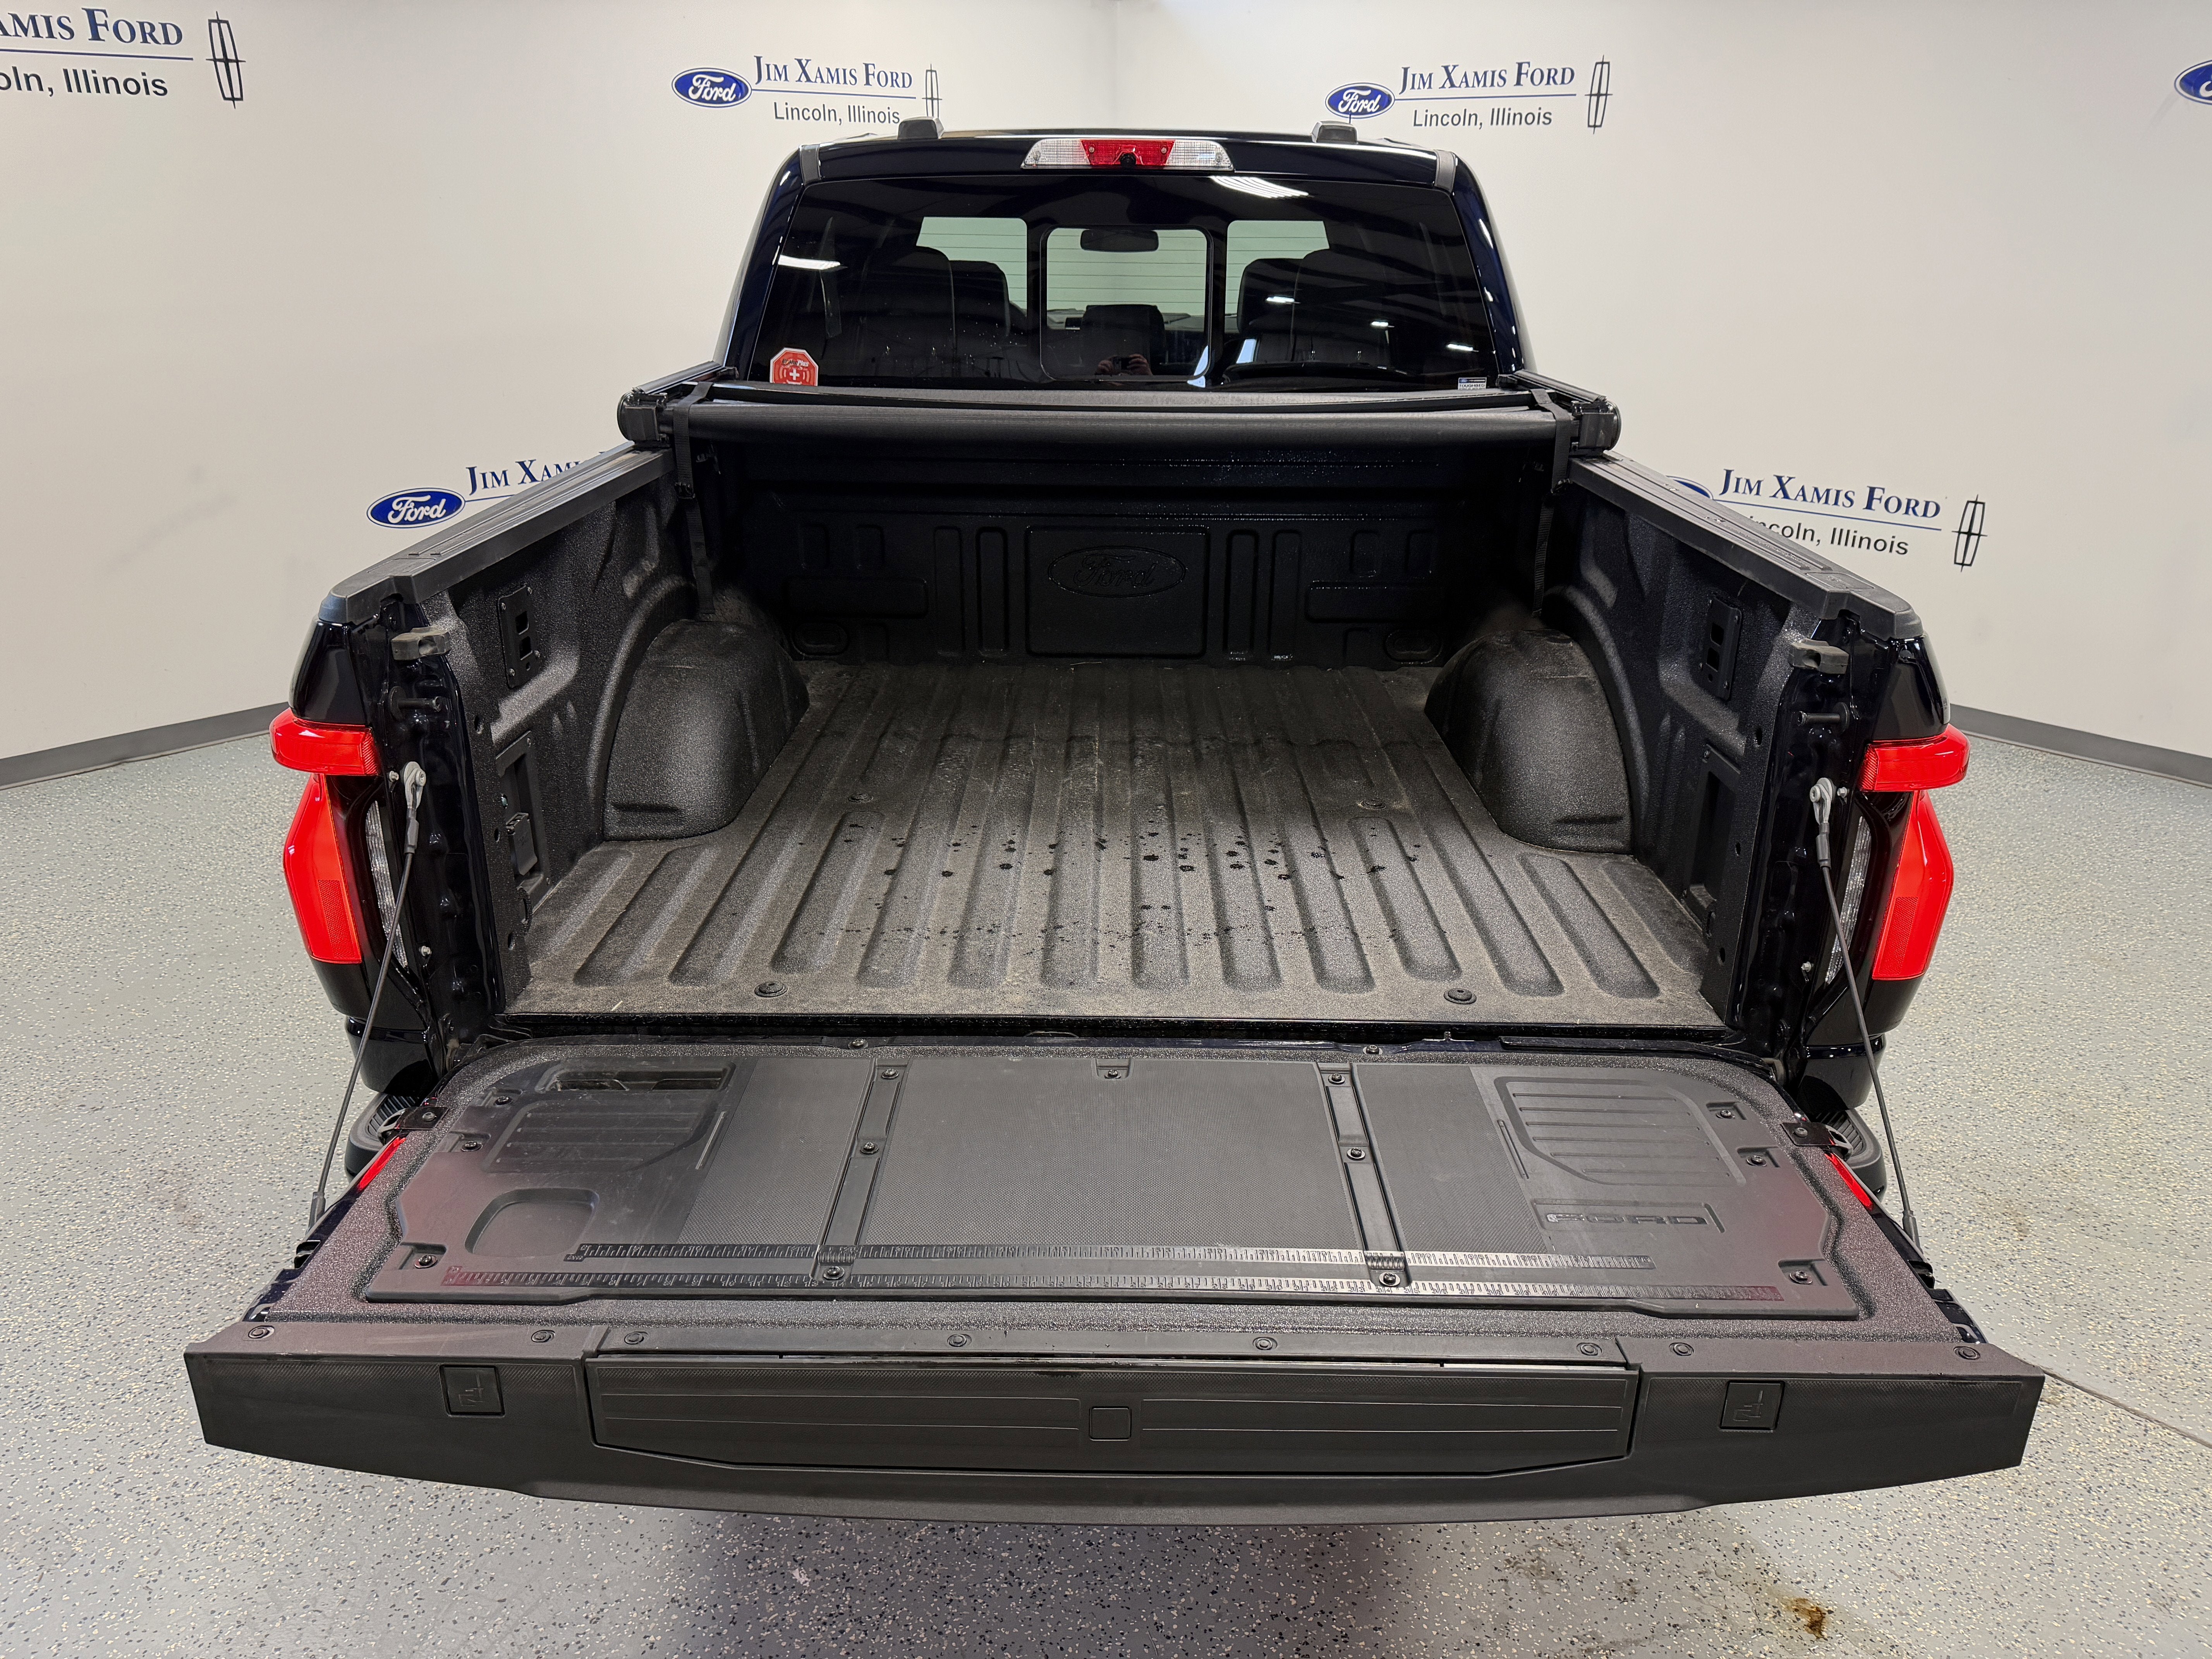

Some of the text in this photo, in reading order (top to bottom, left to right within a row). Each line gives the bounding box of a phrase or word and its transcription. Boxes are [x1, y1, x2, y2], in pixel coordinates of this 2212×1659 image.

[82, 8, 183, 45] FORD
[63, 68, 168, 96] Illinois
[754, 55, 912, 89] JIM XAMIS FORD
[1399, 62, 1575, 94] JIM XAMIS FORD
[774, 102, 900, 125] Lincoln, Illinois
[1413, 107, 1552, 129] Lincoln, Illinois
[466, 459, 580, 495] JIM XAM
[1719, 469, 1941, 519] JIM XAMIS FORD
[1831, 527, 1908, 555] Illinois
[1547, 1214, 1708, 1225] FORD
